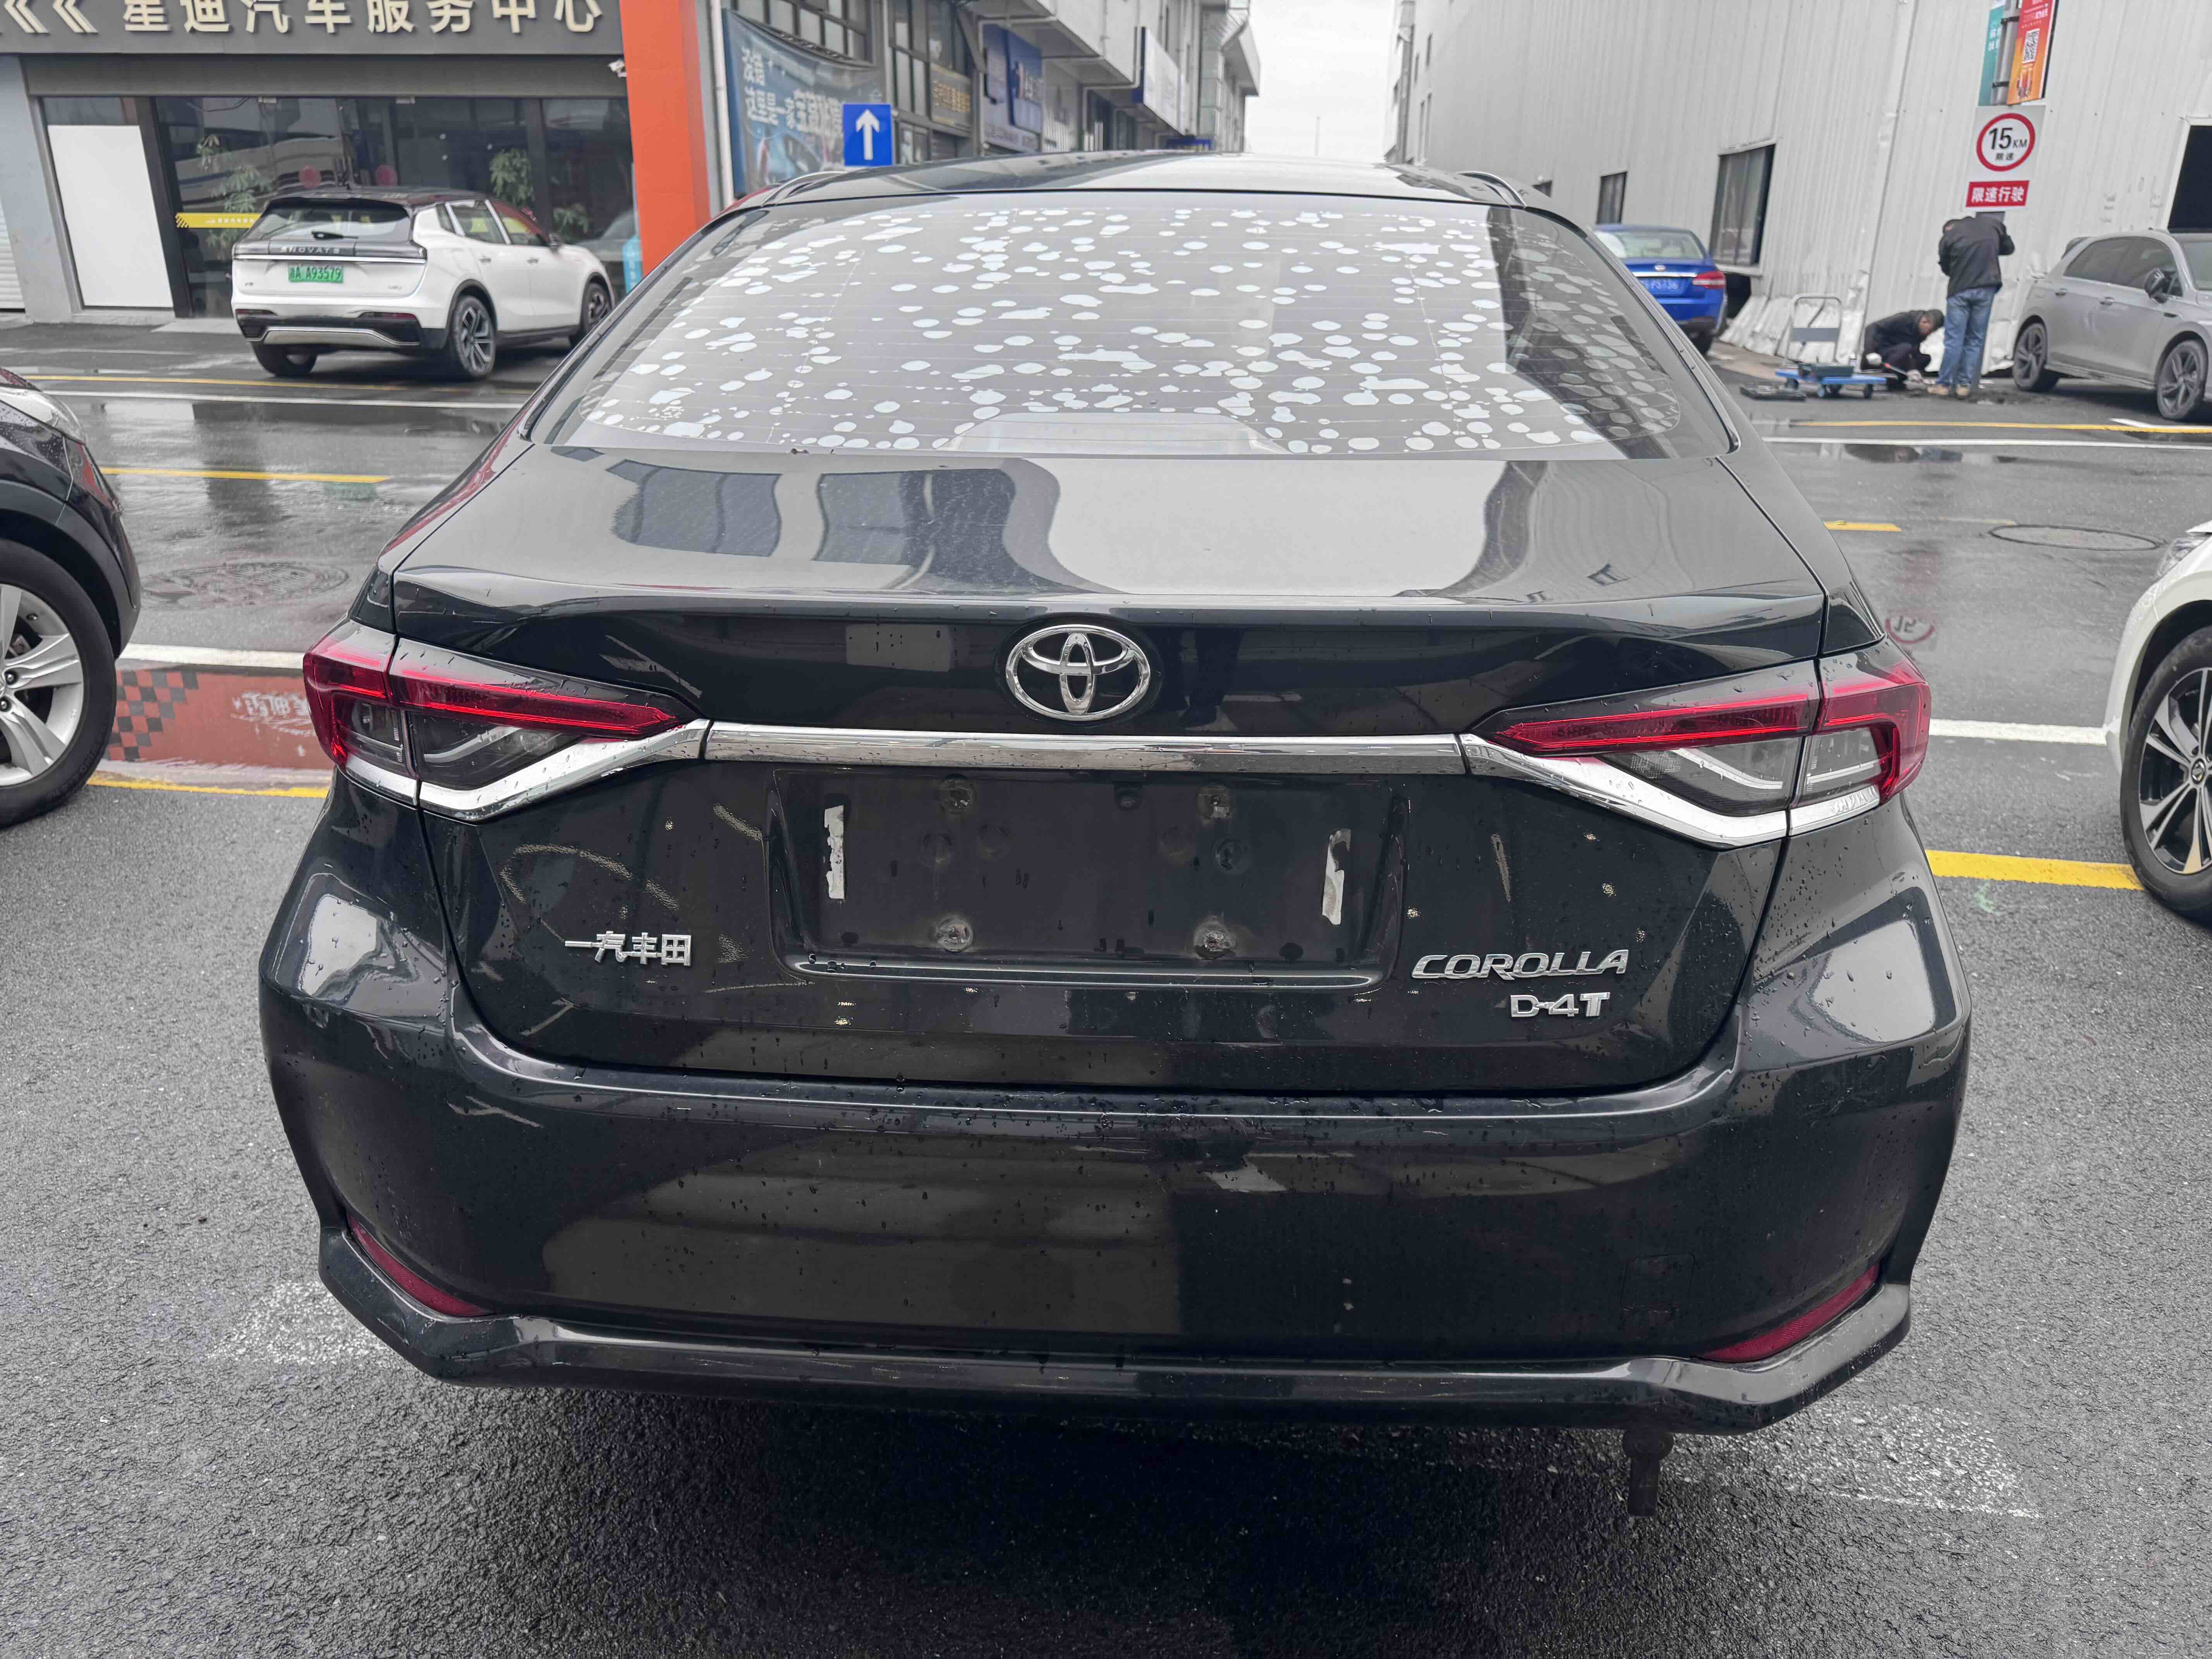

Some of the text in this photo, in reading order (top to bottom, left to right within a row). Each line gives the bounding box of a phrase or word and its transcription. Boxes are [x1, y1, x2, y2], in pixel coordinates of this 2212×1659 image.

[123, 0, 603, 33] 星迪汽车服务中心
[1995, 153, 2014, 161] 限速
[1971, 186, 2025, 203] 限速行驶
[564, 931, 691, 967] 一汽丰田
[1412, 950, 1629, 980] COROLLA
[1510, 992, 1611, 1017] D-4T
